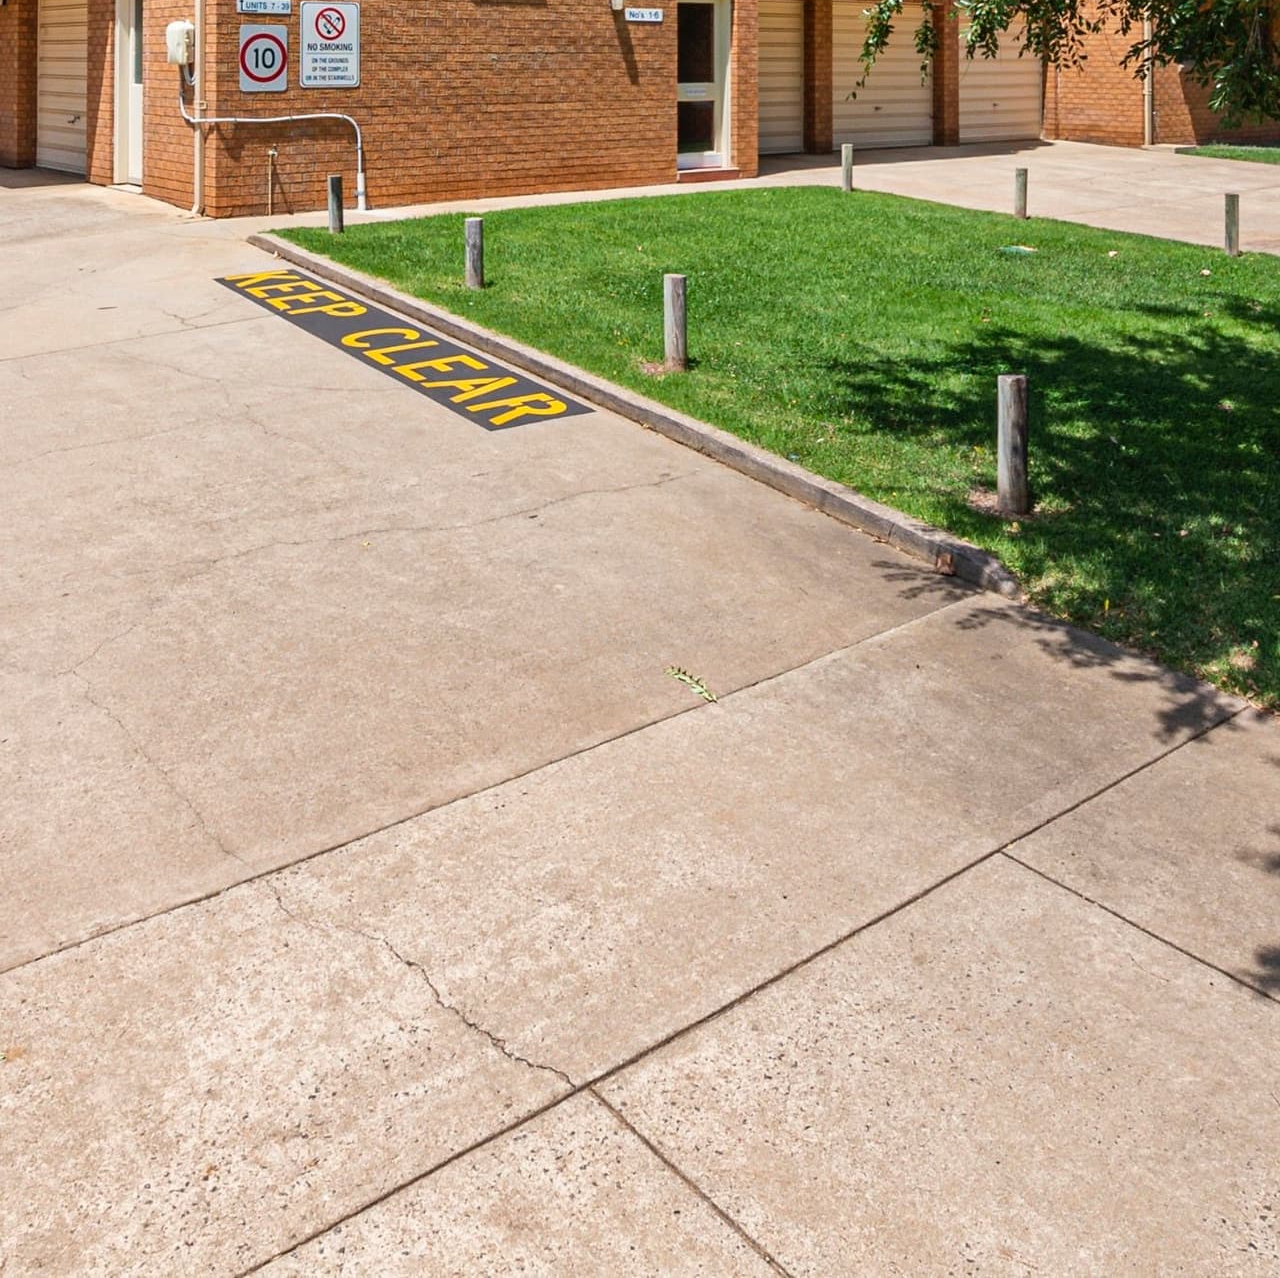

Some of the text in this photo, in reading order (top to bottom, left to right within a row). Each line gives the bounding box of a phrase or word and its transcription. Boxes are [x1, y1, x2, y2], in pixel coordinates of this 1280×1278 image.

[245, 1, 267, 10] UNITS
[307, 42, 353, 51] NO SMOKING
[253, 47, 276, 69] 10
[224, 269, 568, 426] KEEP CLEAR
